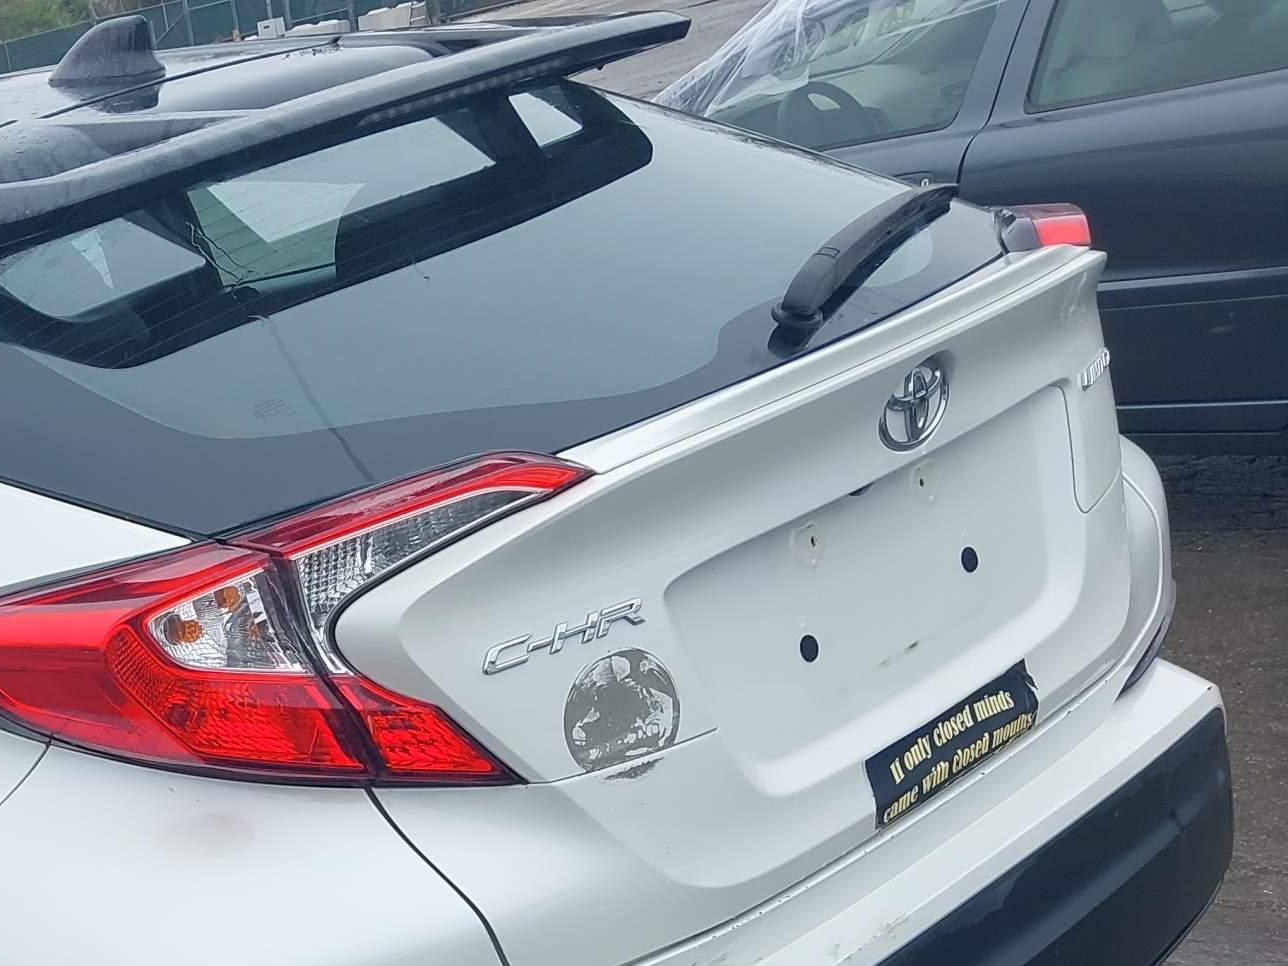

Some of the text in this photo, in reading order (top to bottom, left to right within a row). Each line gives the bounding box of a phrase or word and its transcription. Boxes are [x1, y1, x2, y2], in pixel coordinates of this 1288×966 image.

[482, 597, 646, 675] C-HR
[883, 712, 1033, 823] came with closed mouths
[903, 734, 932, 771] only
[933, 704, 974, 747] closed
[973, 690, 1015, 722] minds
